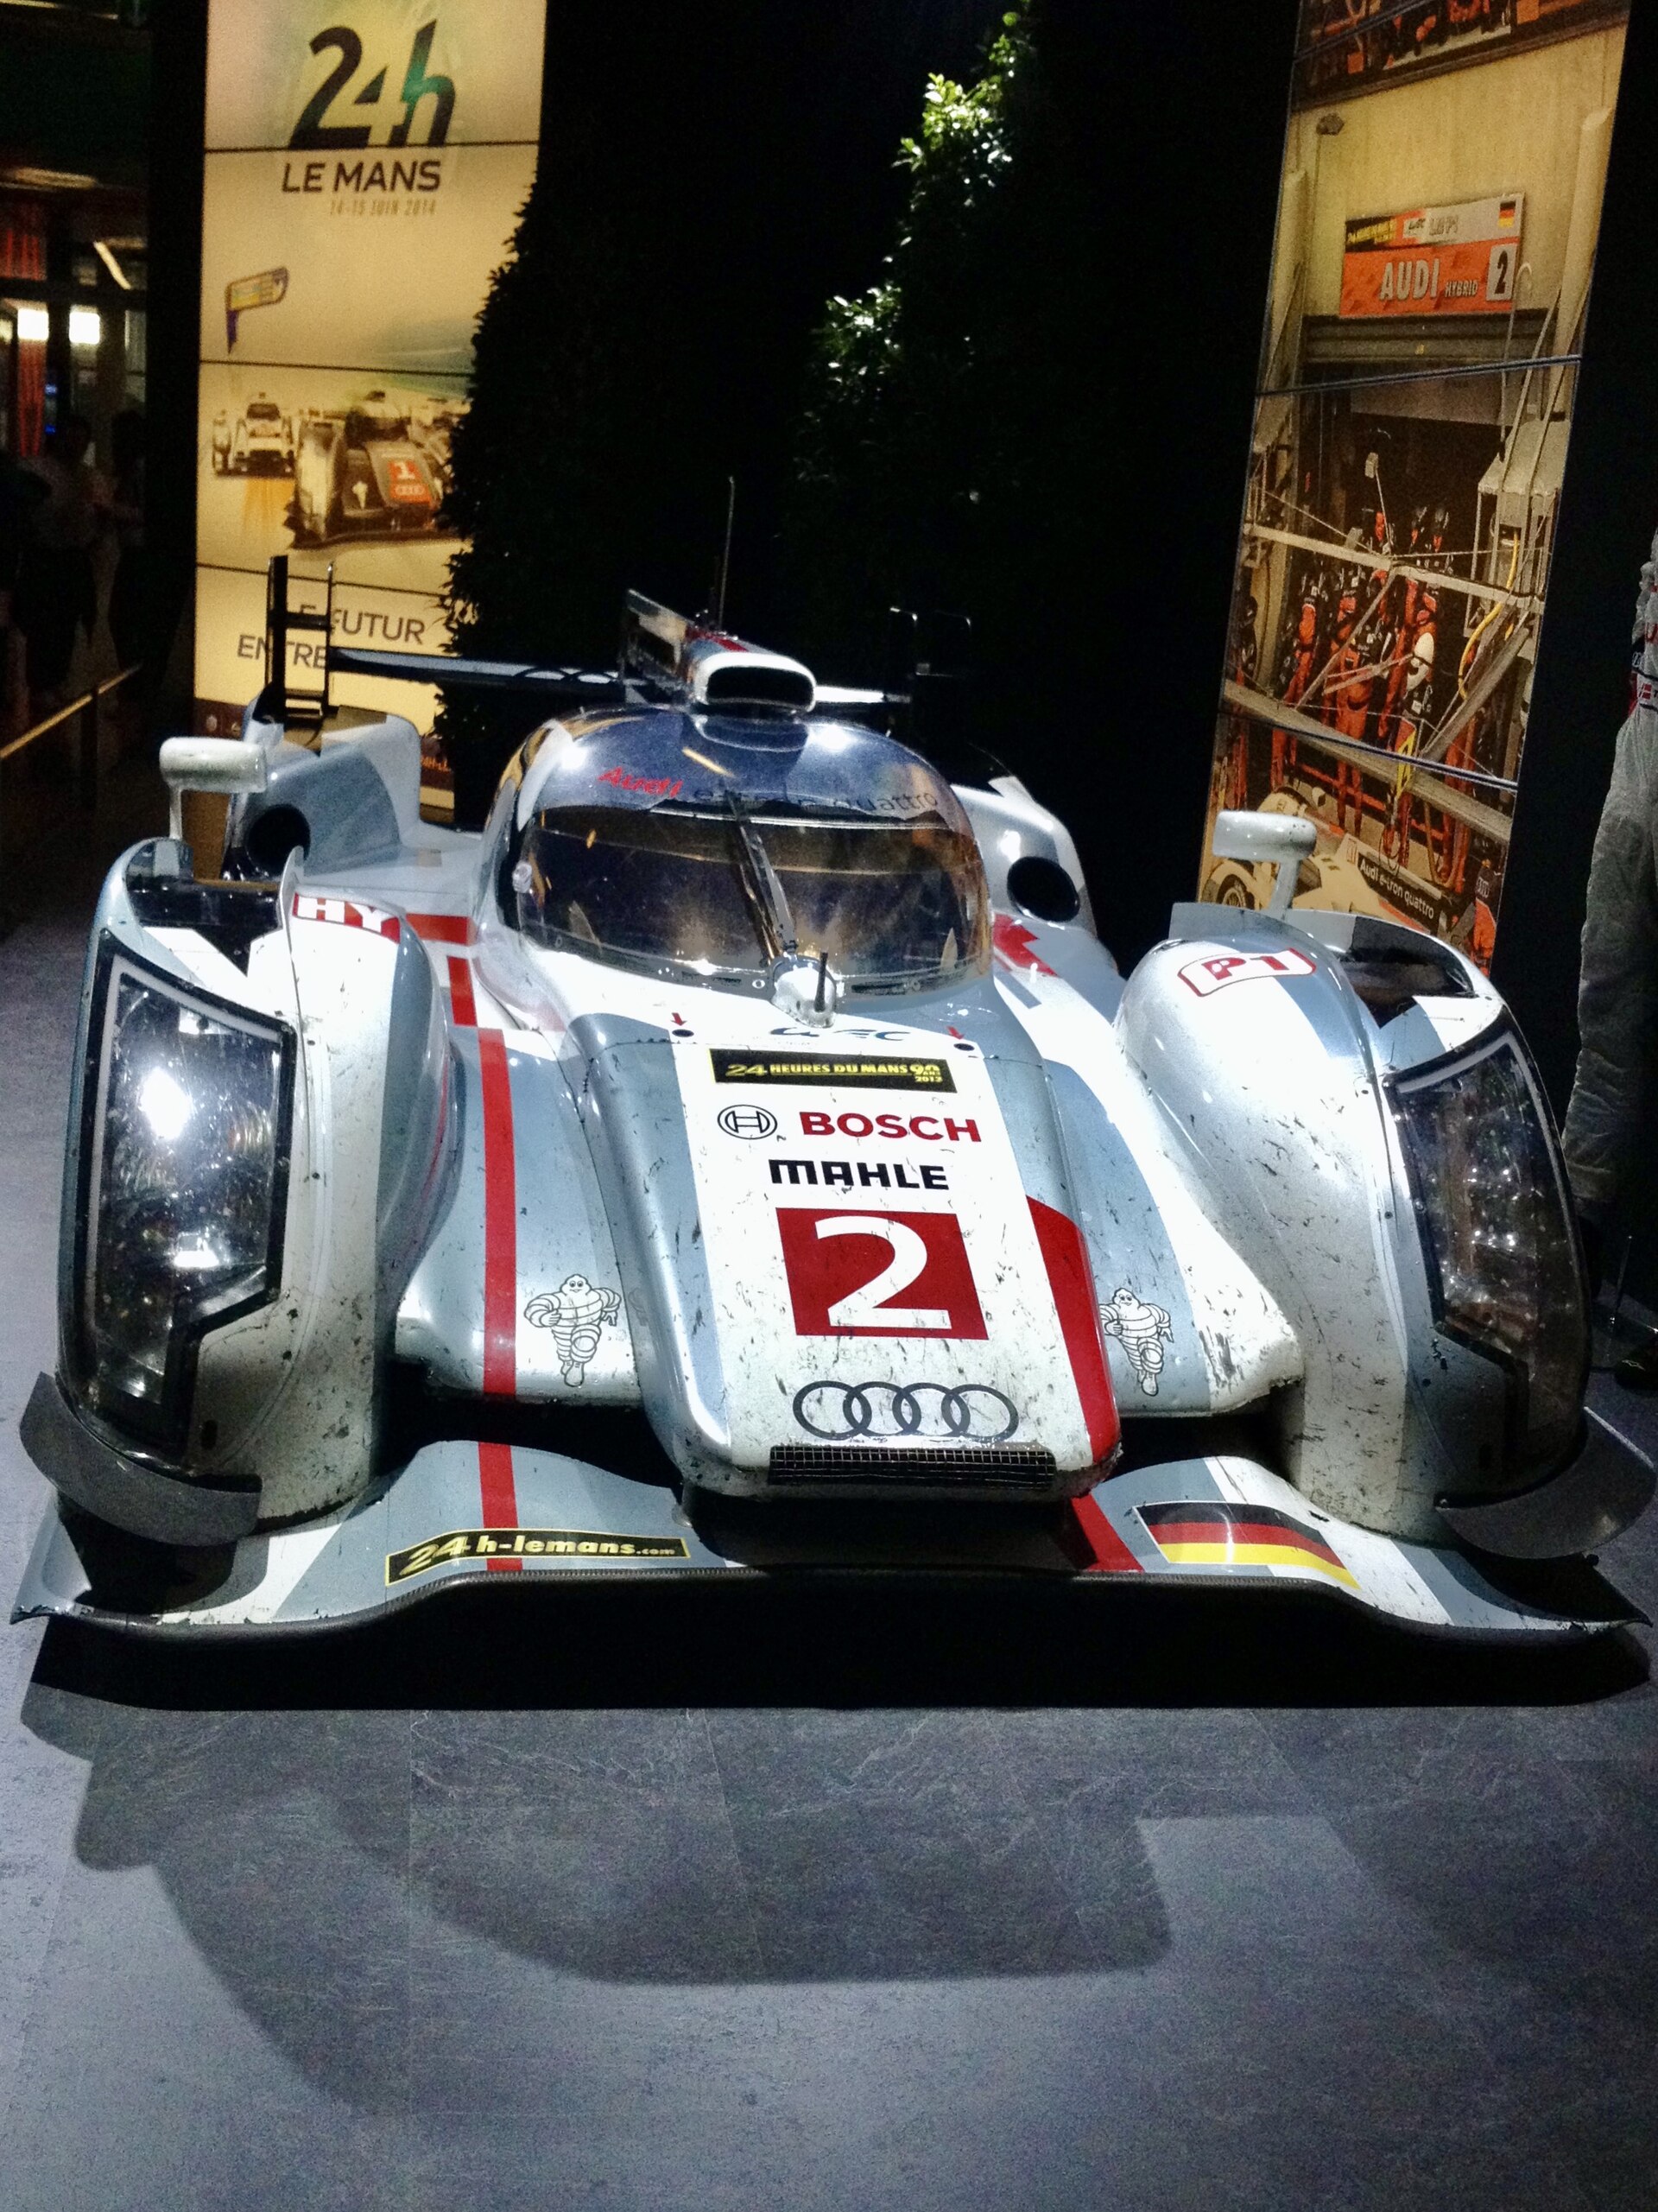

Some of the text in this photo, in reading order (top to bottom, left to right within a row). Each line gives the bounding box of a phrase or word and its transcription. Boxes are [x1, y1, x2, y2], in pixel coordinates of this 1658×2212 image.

[288, 17, 457, 150] 24h
[282, 160, 442, 193] LE MANS
[1378, 258, 1479, 301] AUDI HYBRID
[1494, 250, 1509, 295] 2
[1359, 858, 1435, 920] Audi e-tron quattro
[1200, 955, 1290, 980] P1
[725, 1063, 768, 1077] 24
[769, 1063, 831, 1074] HEURES
[833, 1063, 858, 1074] DU
[861, 1063, 908, 1074] MANS
[799, 1111, 982, 1143] BOSCH
[768, 1159, 950, 1190] MAHLE
[814, 1214, 952, 1329] 2
[399, 1536, 471, 1576] 24
